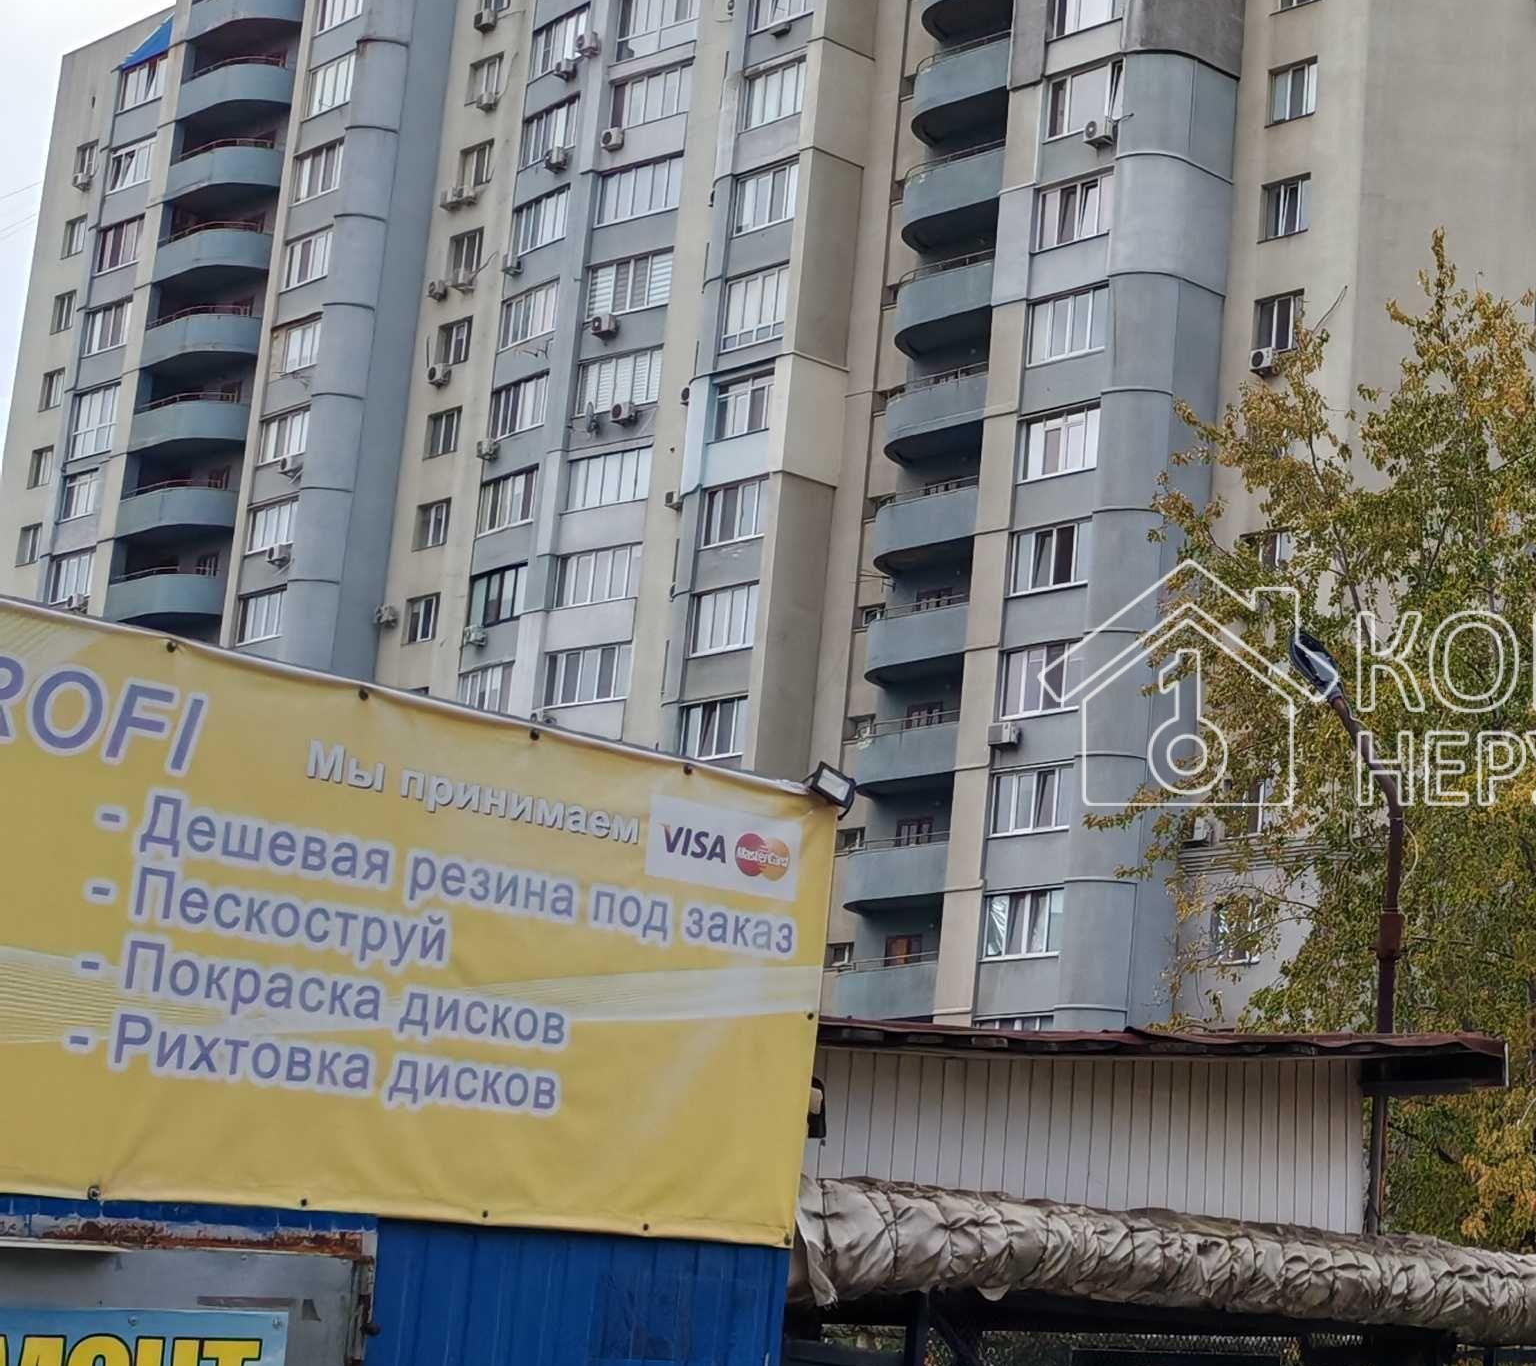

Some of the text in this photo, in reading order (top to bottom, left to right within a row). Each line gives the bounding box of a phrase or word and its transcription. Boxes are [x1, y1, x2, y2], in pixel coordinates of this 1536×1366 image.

[305, 739, 640, 845] Мы принимаем
[658, 822, 727, 864] VISA
[134, 867, 446, 967] Пескоструй
[139, 795, 390, 885] Дешевая
[408, 855, 576, 918] резина
[592, 889, 669, 940] под
[685, 906, 794, 955] заказ
[124, 940, 382, 1021] Покраска
[399, 991, 567, 1045] дисков
[114, 1013, 370, 1090] Рихтовка
[387, 1058, 557, 1110] дисков
